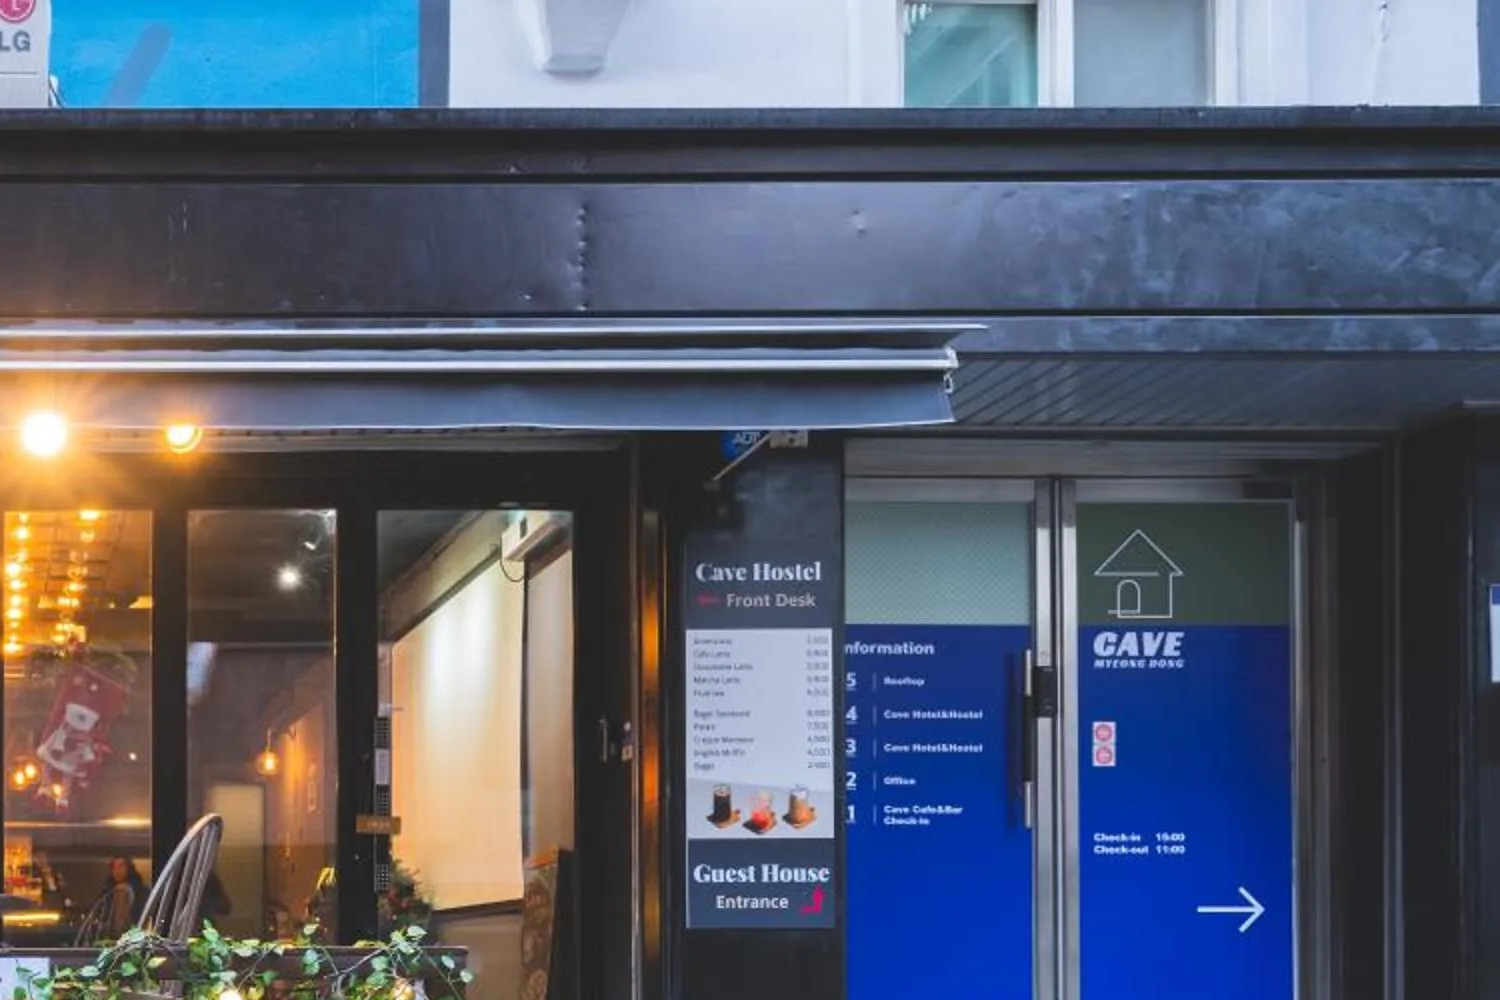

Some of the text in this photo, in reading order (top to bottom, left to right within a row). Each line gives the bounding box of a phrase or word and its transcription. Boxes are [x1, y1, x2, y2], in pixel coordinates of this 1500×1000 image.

[695, 560, 821, 582] Cave Hostel
[726, 592, 817, 608] Front Desk
[845, 641, 936, 655] nformation
[1093, 631, 1185, 657] CAVE
[845, 671, 925, 688] 5 Rooftop
[845, 705, 984, 721] 4 Cave Hotel&Hostel
[845, 738, 984, 754] 3 Cave Hotel&Hostel
[845, 771, 857, 787] 2
[846, 804, 856, 821] 1
[883, 804, 910, 814] Cave
[693, 863, 831, 883] Guest House
[715, 895, 790, 909] Entrance
